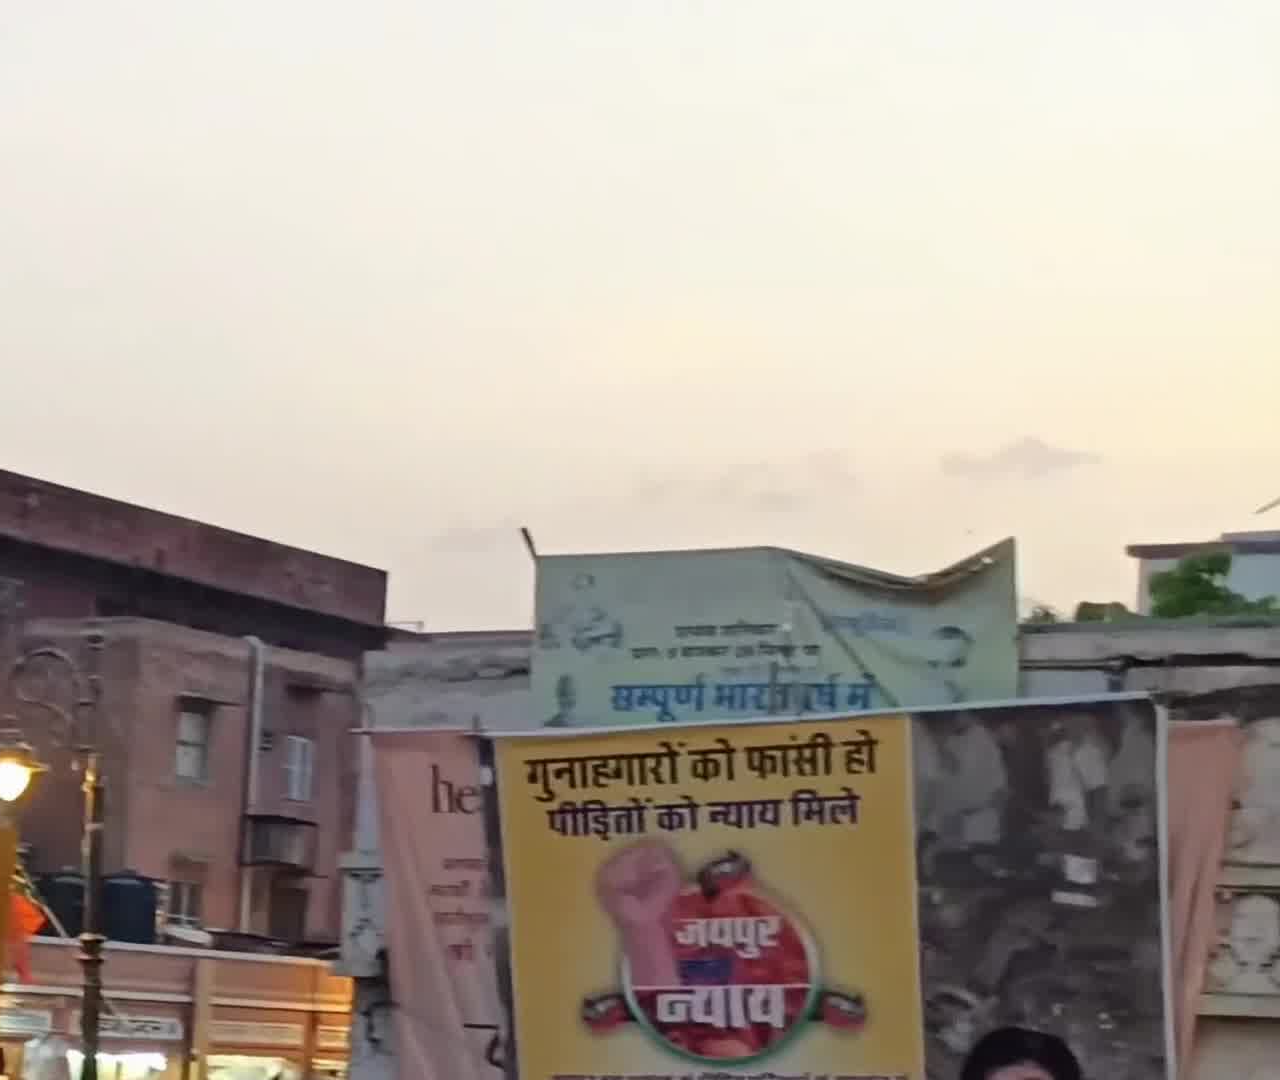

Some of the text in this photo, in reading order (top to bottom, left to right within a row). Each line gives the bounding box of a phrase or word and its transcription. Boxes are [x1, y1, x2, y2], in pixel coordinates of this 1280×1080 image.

[524, 730, 879, 802] गुनाहगारों को फांसी हो
[547, 786, 861, 841] पीड़ितों को न्याय मिले
[673, 916, 781, 959] जयपुर
[654, 984, 787, 1029] न्याय
